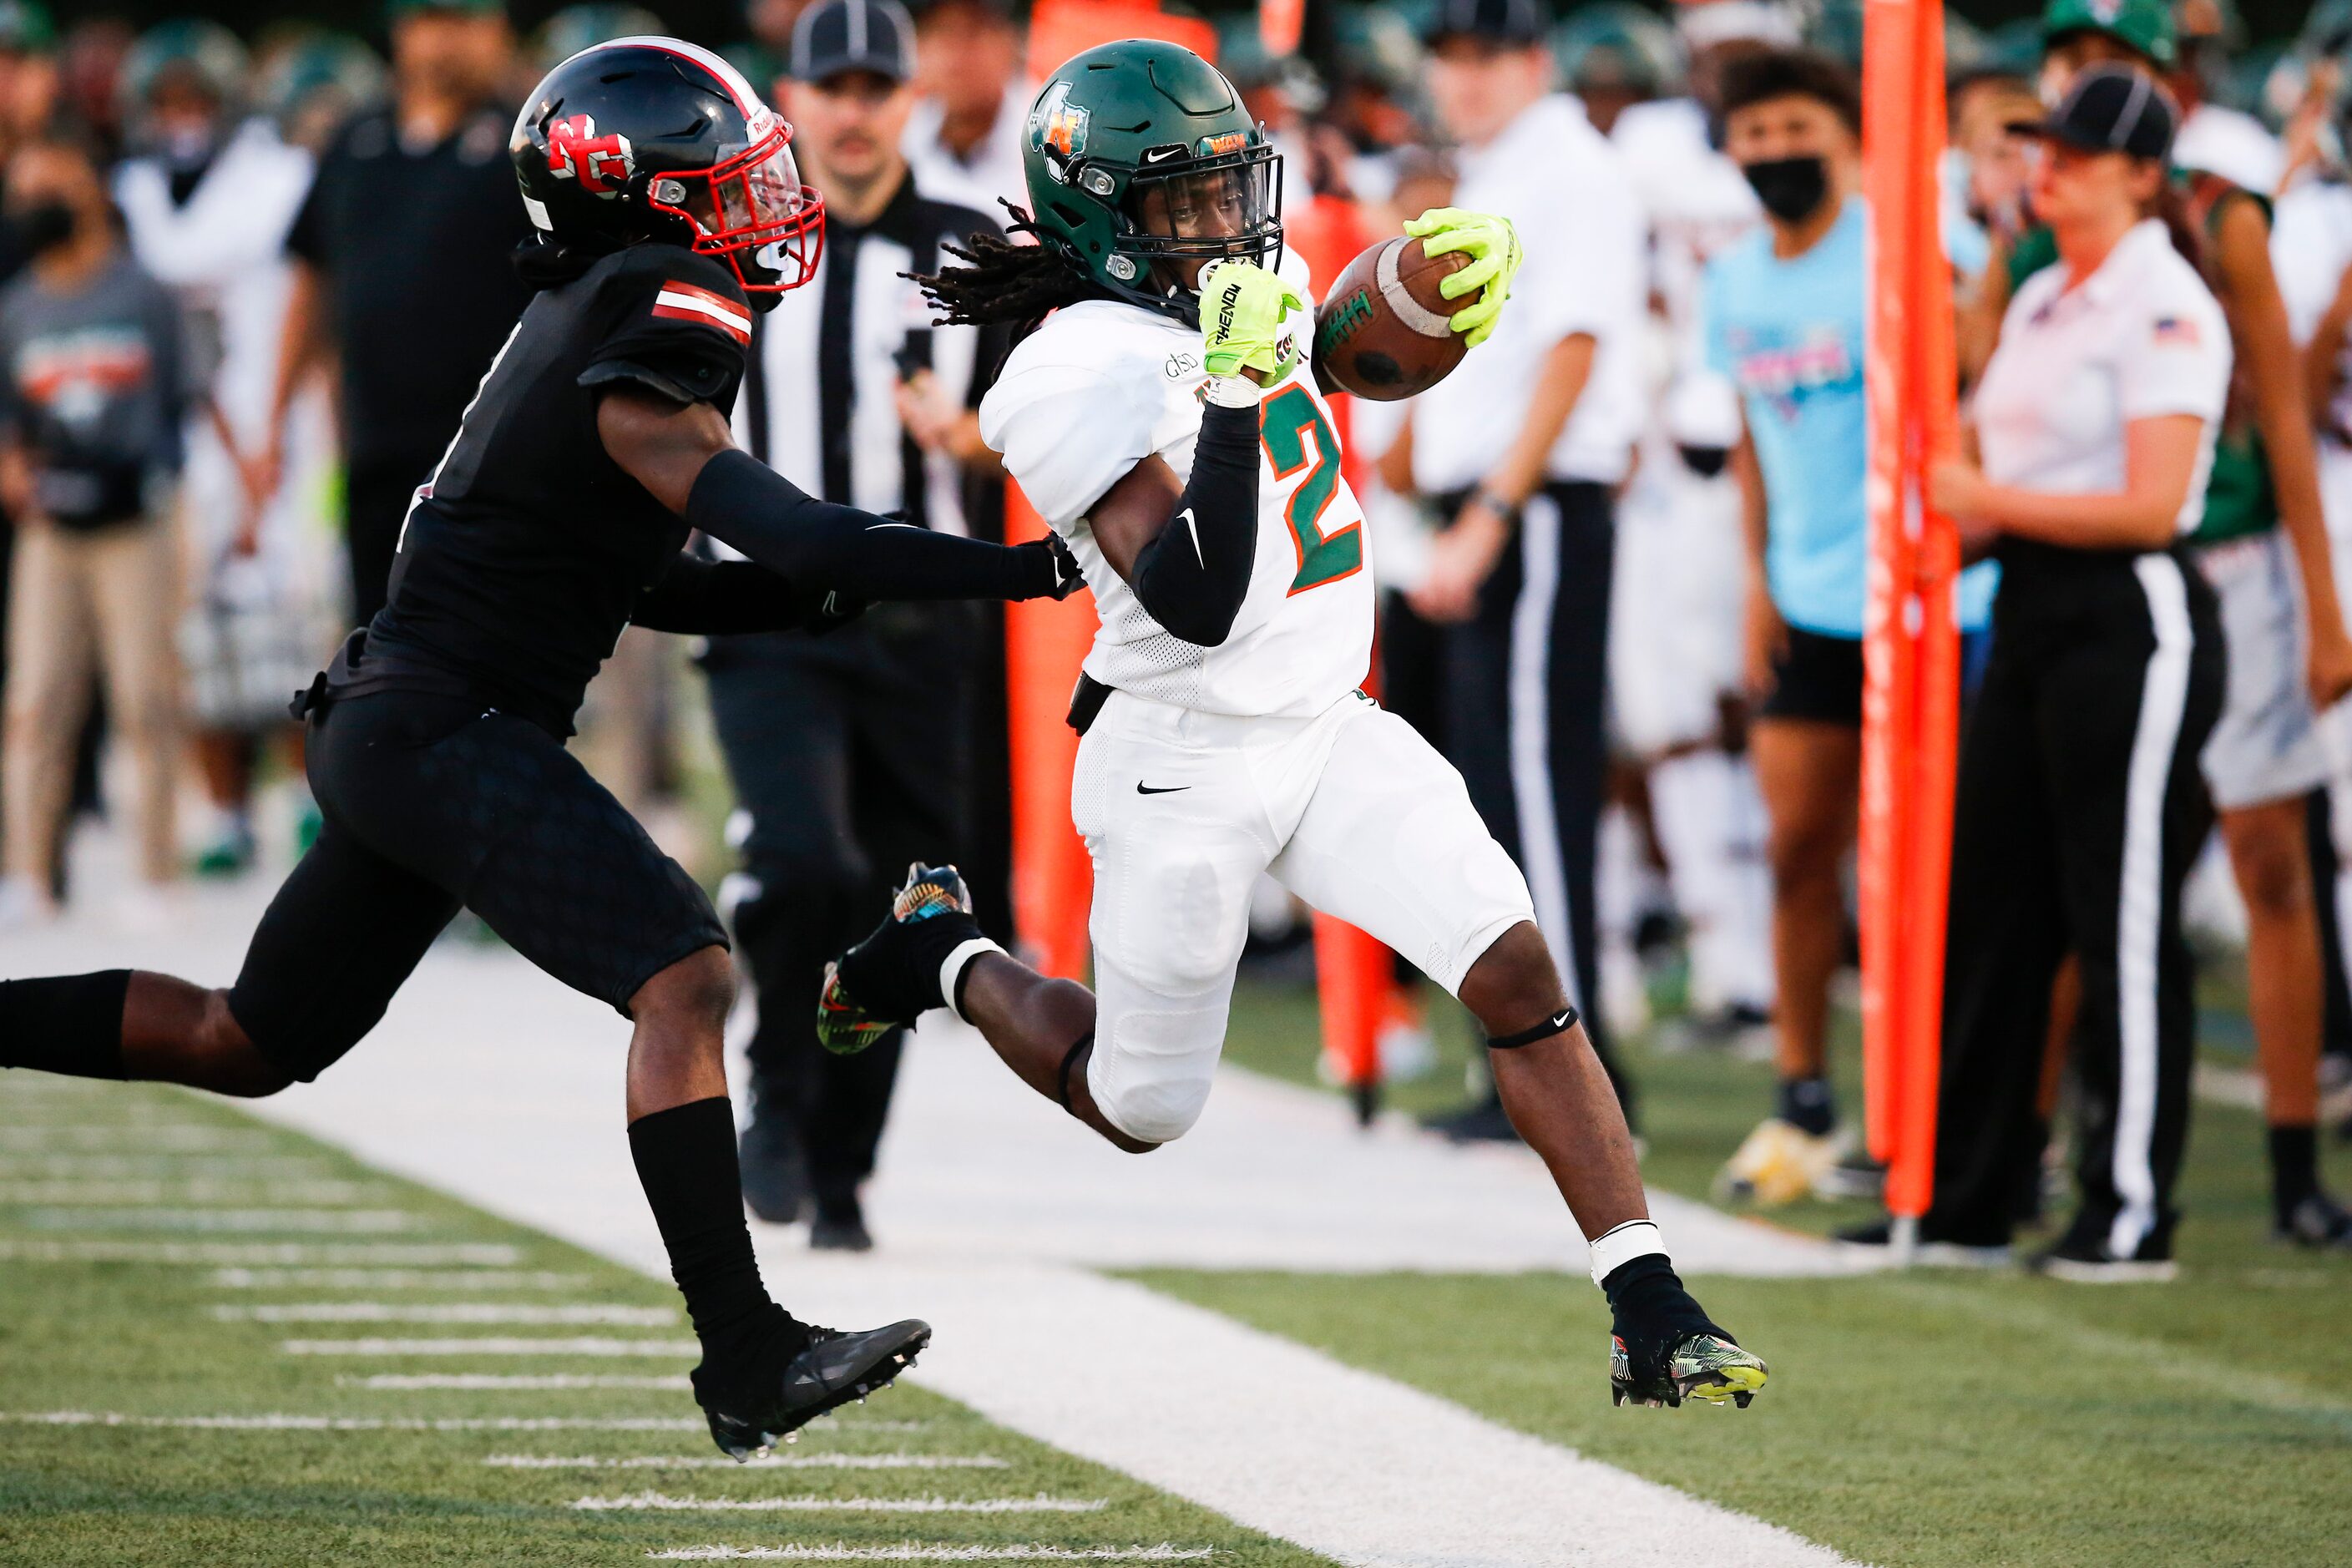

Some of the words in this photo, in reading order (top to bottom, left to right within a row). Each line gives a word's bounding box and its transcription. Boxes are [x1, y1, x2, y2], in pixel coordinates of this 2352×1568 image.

[1215, 283, 1242, 345] PHENOM
[1166, 353, 1198, 377] GISD
[1260, 381, 1363, 599] 2
